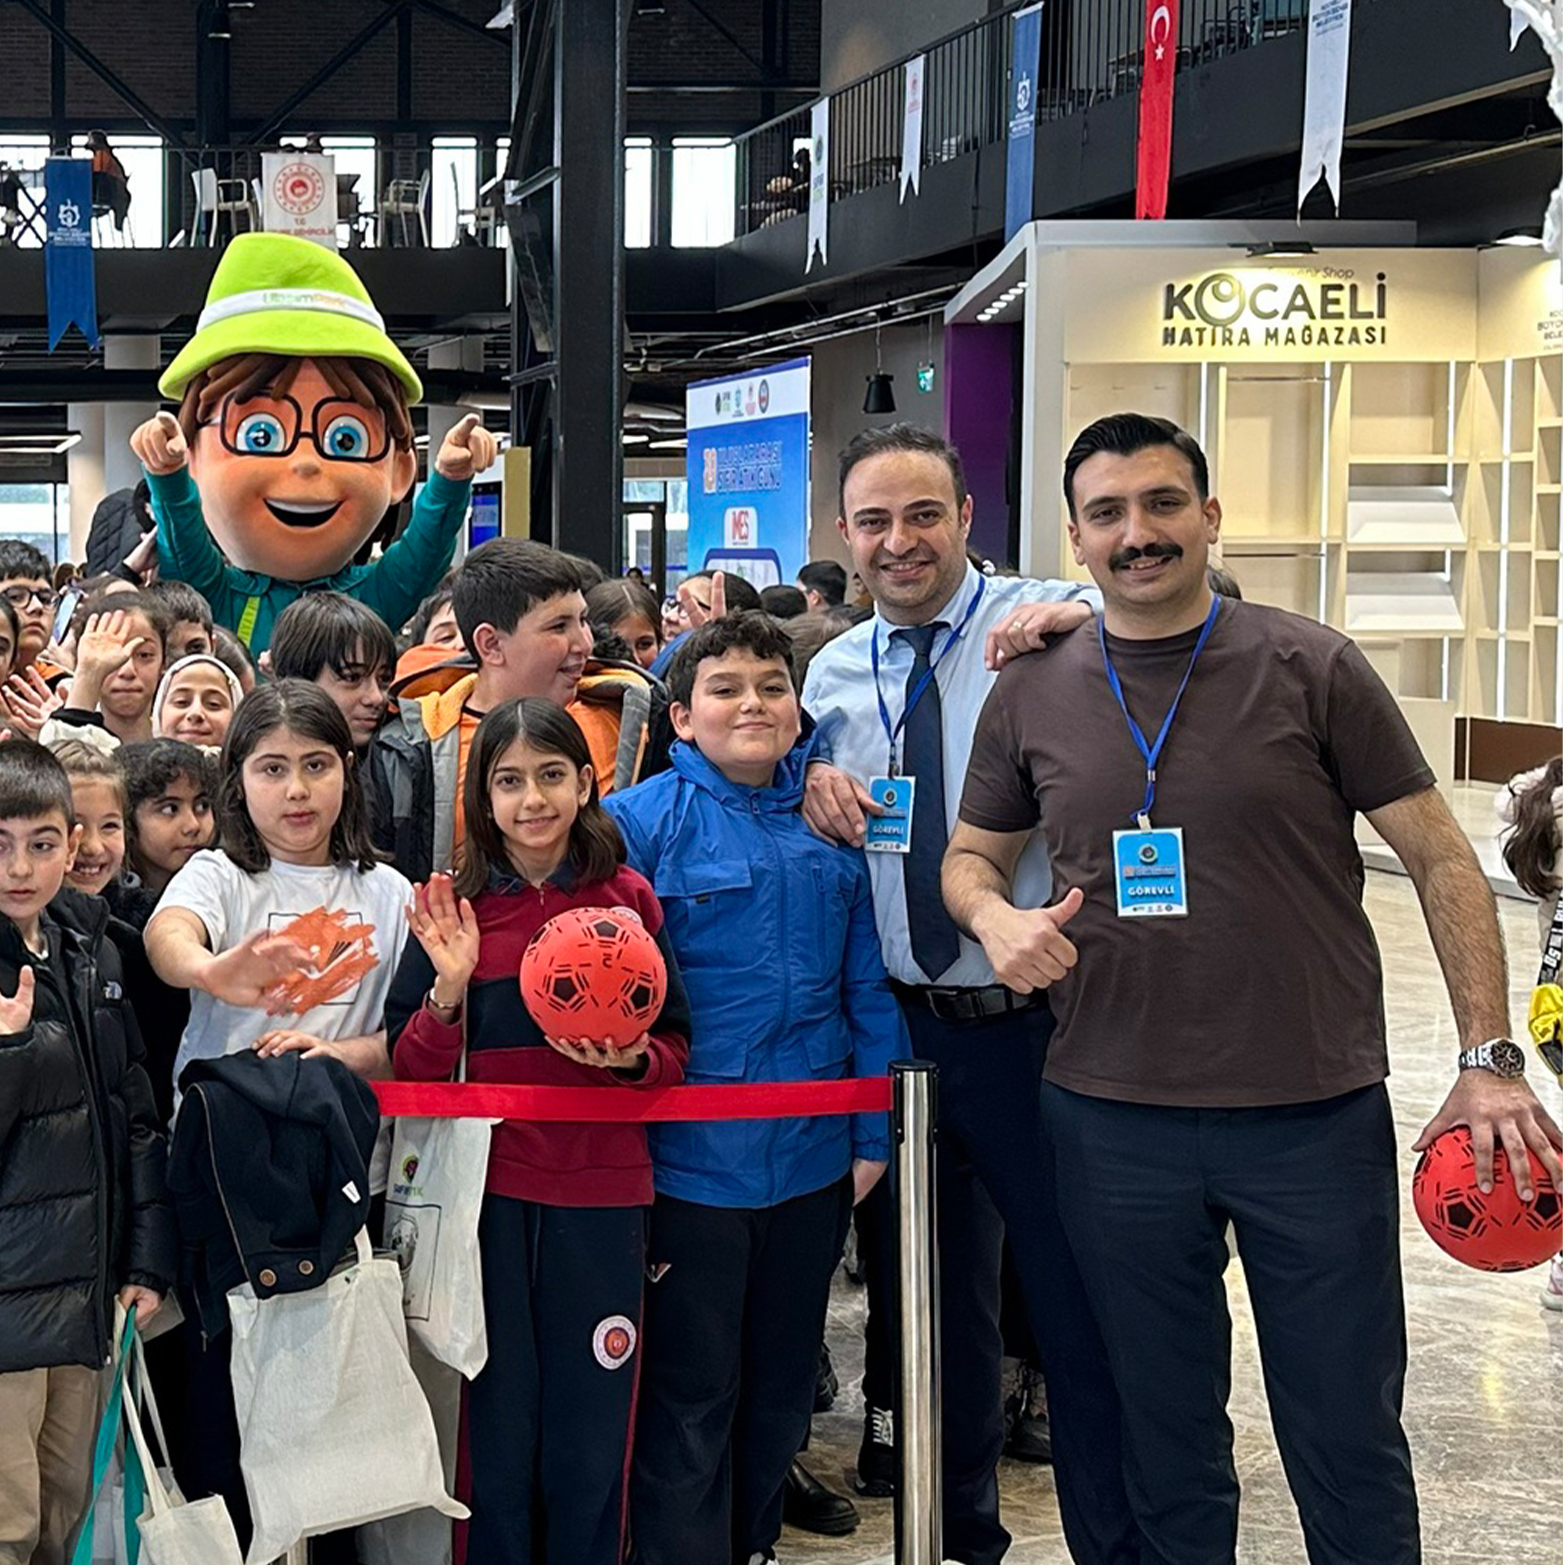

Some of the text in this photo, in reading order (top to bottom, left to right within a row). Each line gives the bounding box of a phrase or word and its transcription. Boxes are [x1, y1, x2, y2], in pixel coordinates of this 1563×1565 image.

[1322, 266, 1355, 281] Shop
[1163, 272, 1387, 327] KOCAELİ
[1162, 324, 1387, 347] HATIRA MAĞAZASI
